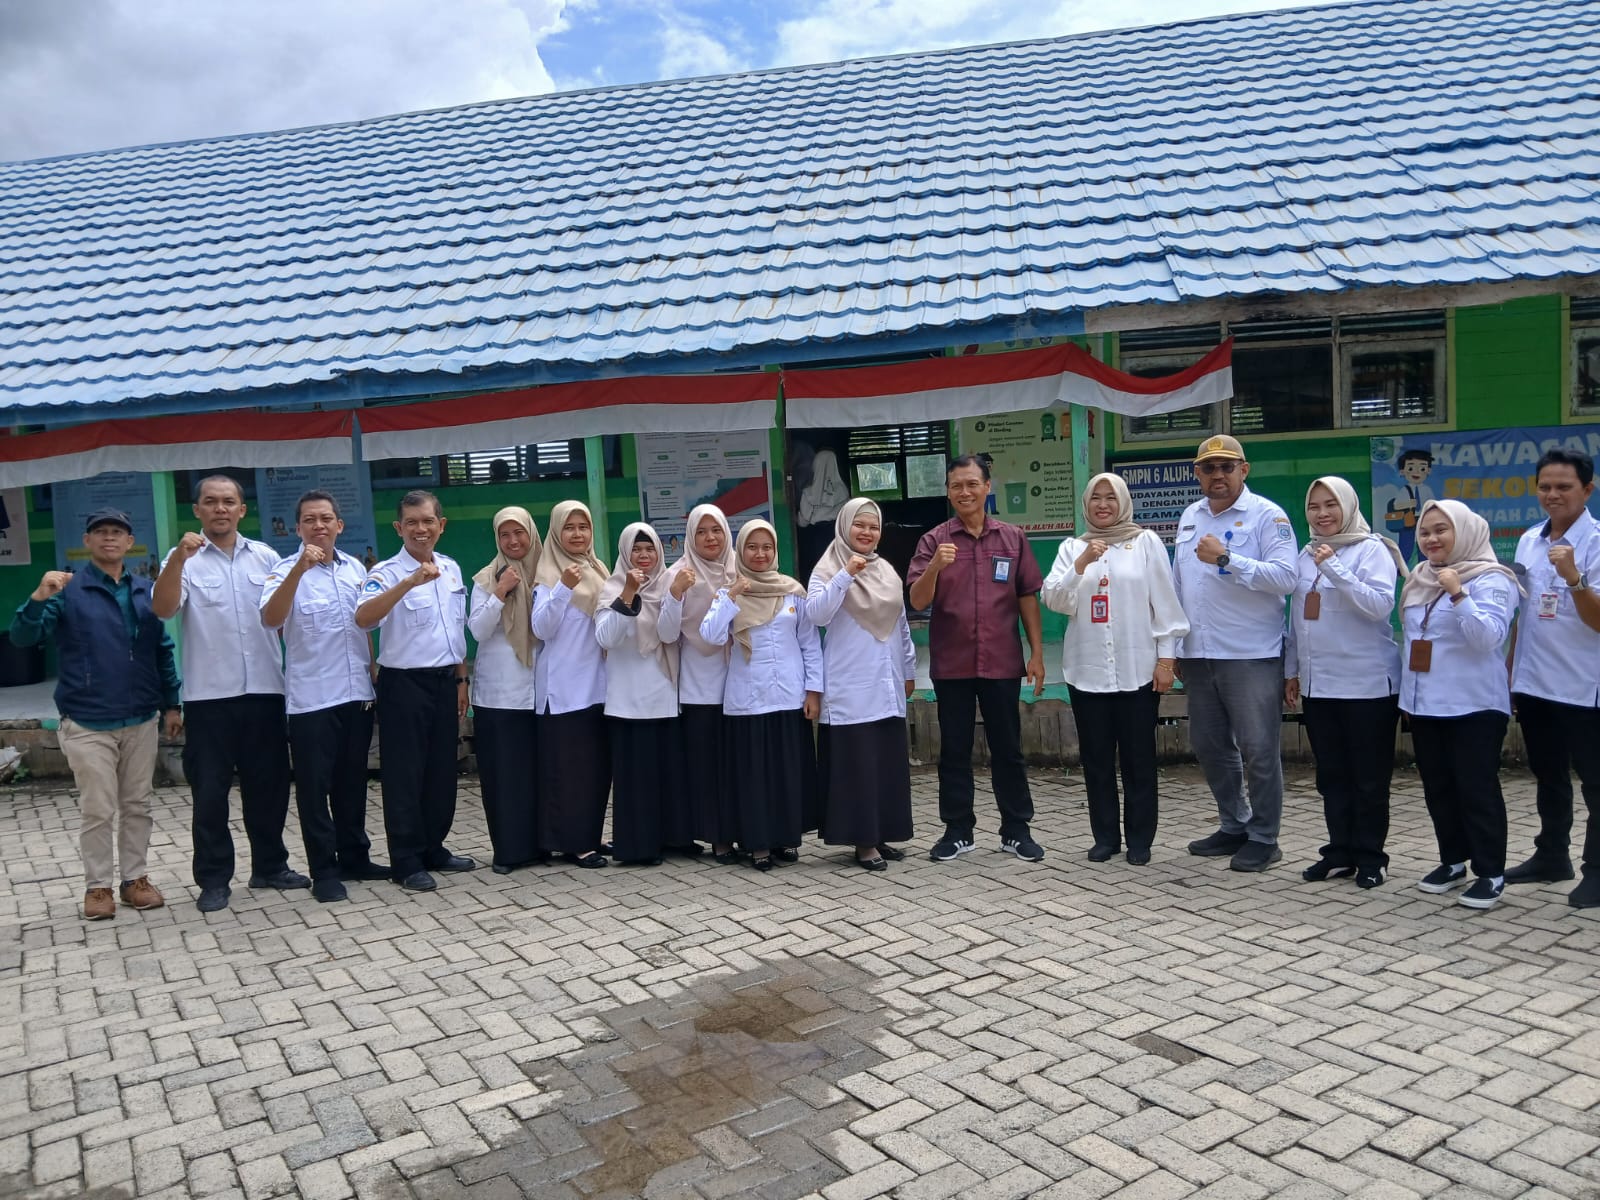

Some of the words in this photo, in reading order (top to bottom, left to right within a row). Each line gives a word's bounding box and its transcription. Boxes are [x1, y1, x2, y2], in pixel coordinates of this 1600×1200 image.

[1122, 468, 1151, 485] SMPN
[1154, 467, 1160, 483] 6
[1131, 490, 1184, 499] UDAYAKAN
[1143, 499, 1184, 507] DENGAN
[1133, 511, 1182, 520] KEAMA
[1480, 508, 1521, 521] MAH
